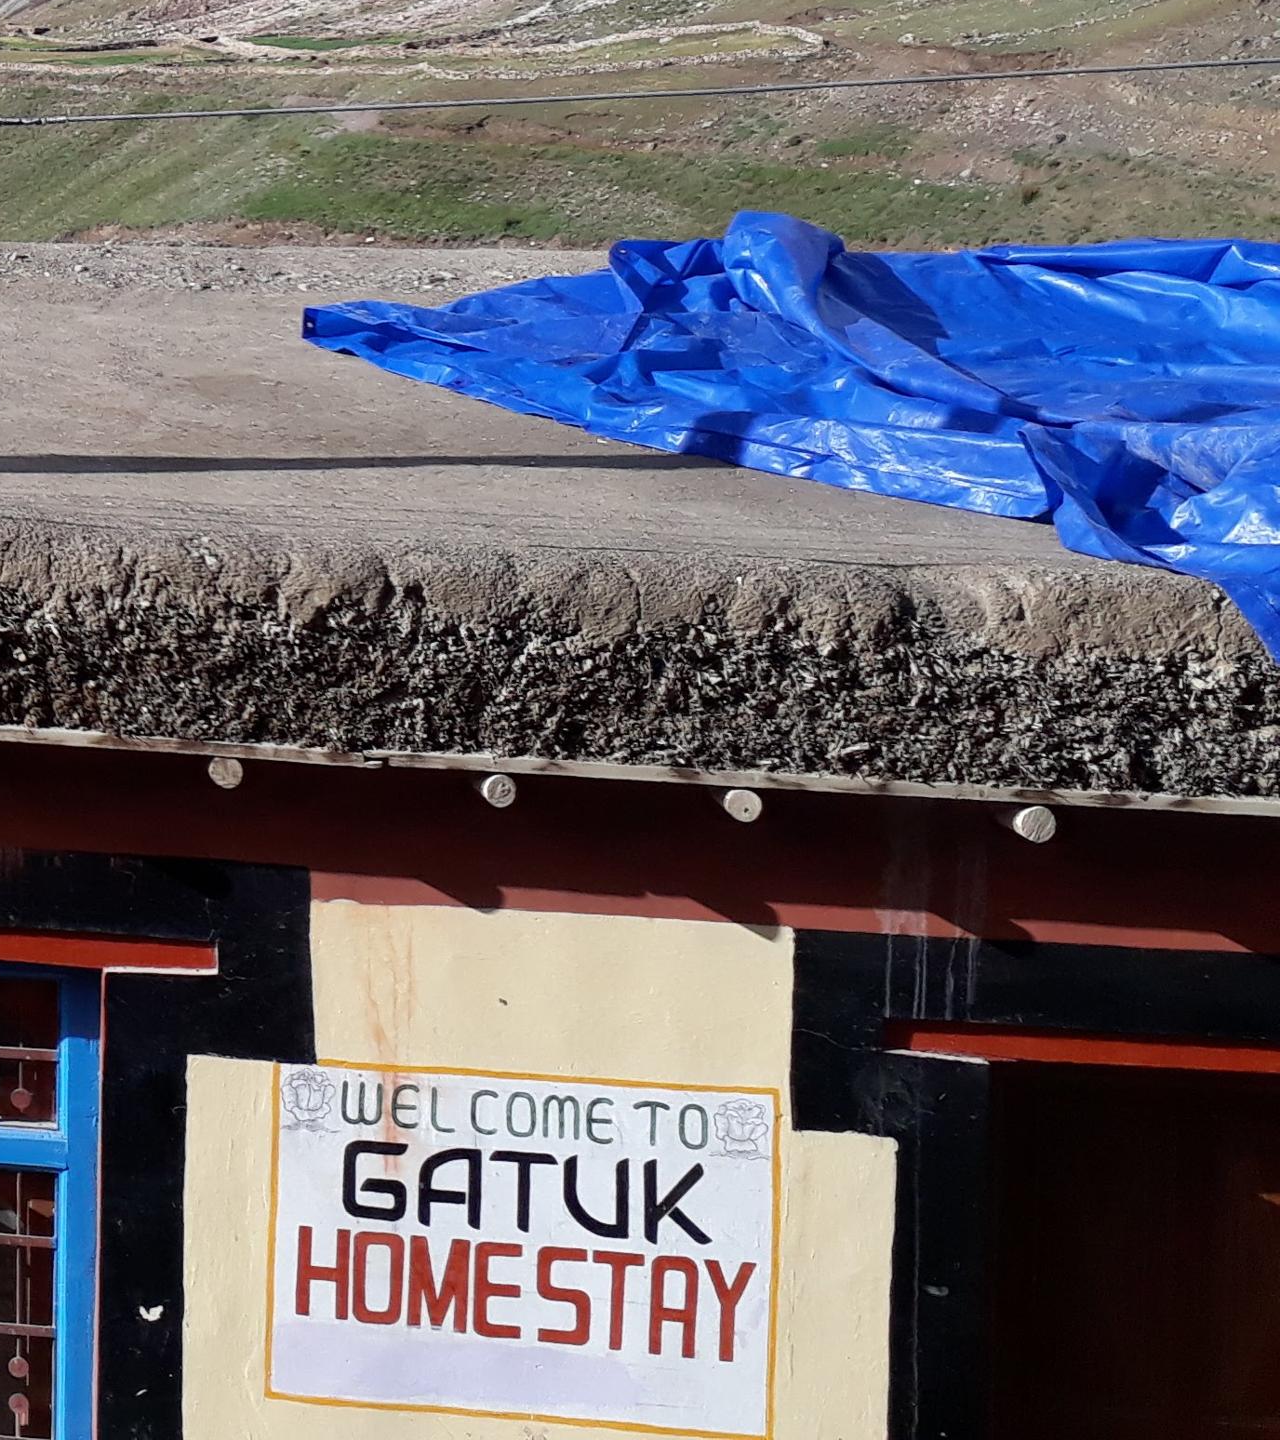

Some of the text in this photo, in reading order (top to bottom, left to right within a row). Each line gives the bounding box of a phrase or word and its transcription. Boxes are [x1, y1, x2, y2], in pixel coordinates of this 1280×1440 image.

[341, 1080, 708, 1149] WELCOME TO
[342, 1140, 712, 1245] GATUK
[295, 1225, 756, 1362] HOMESTAY
